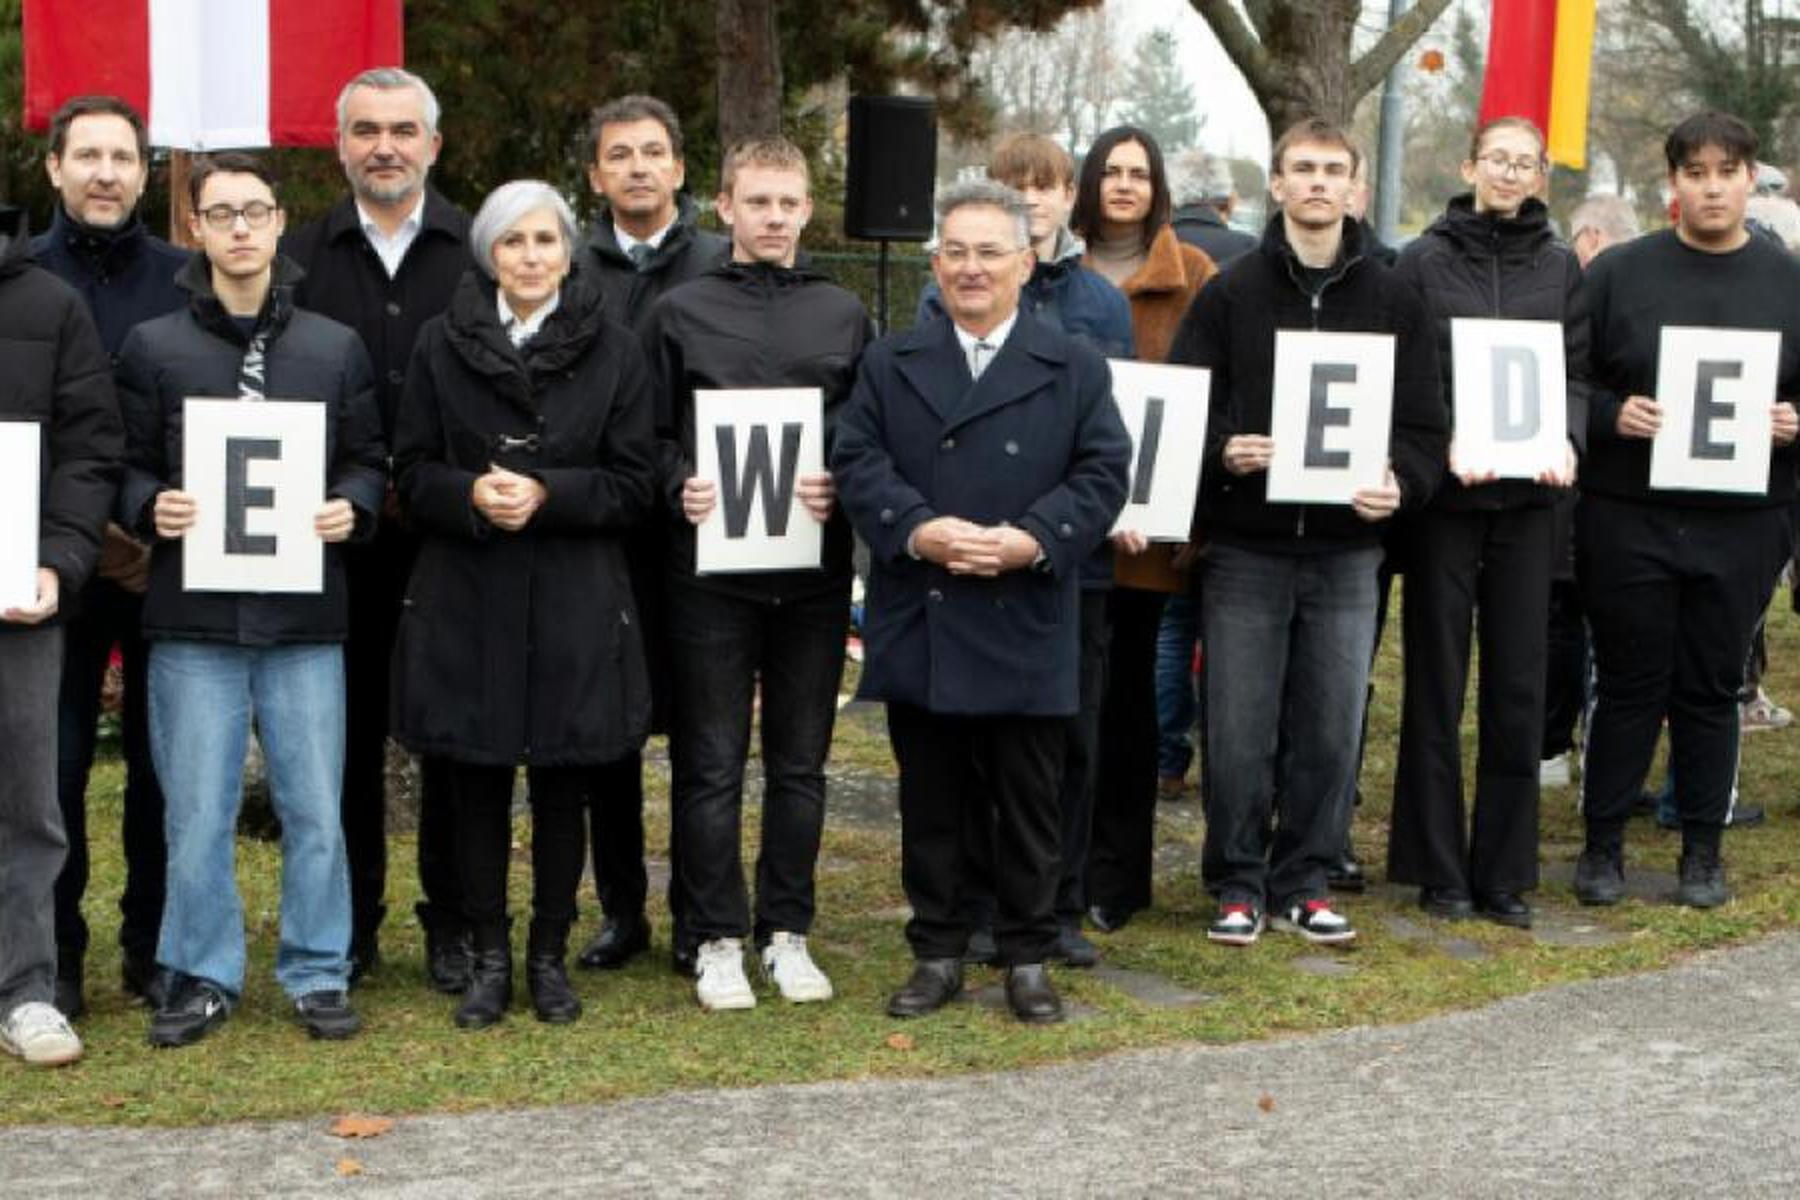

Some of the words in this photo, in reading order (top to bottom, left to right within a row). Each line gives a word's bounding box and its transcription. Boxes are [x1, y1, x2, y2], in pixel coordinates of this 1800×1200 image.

[1303, 363, 1357, 468] E
[1490, 345, 1541, 443] D
[1690, 360, 1744, 460] E
[225, 437, 281, 555] E
[715, 422, 803, 538] W
[1132, 397, 1164, 504] I
